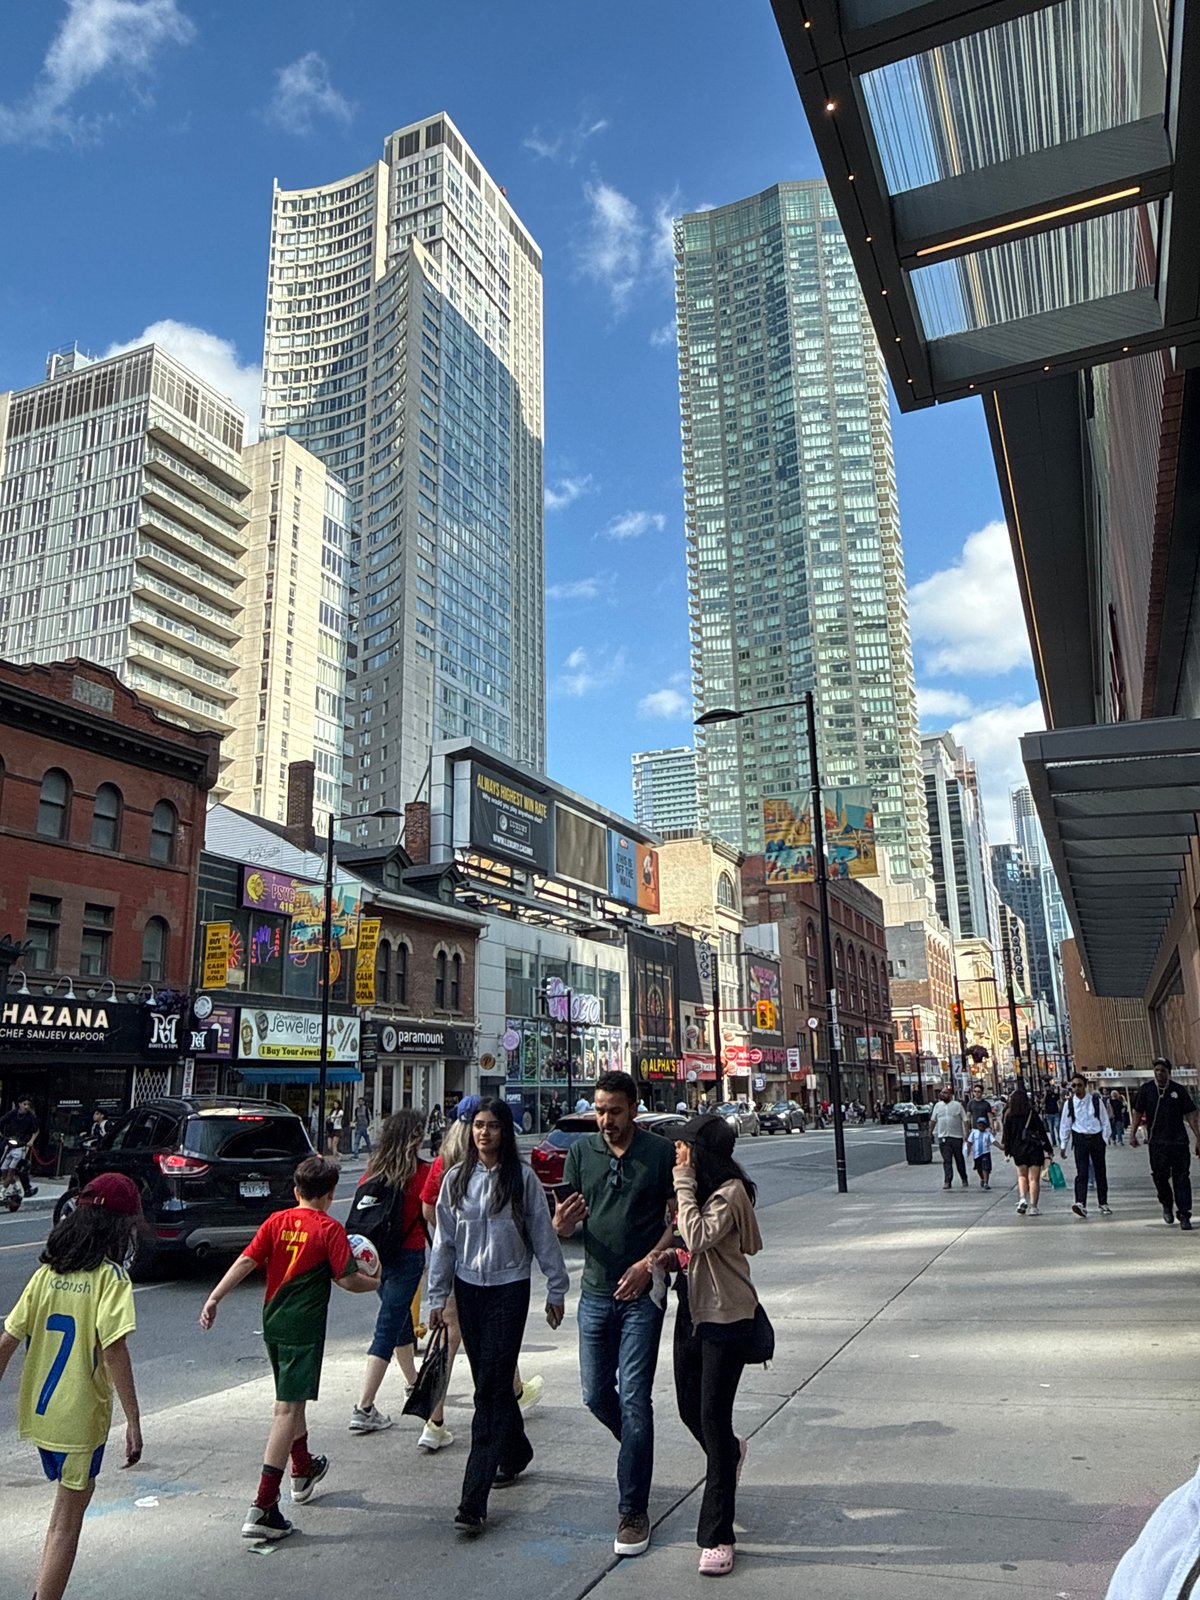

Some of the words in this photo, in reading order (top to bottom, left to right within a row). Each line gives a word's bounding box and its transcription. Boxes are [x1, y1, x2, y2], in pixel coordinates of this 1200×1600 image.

[477, 773, 500, 797] ALWAYS
[500, 784, 523, 807] HIGHEST
[523, 796, 534, 813] WIN
[534, 801, 548, 819] RATE
[356, 972, 373, 981] CASH
[355, 991, 374, 1000] GOLD
[276, 1013, 303, 1022] Downtown
[270, 1016, 323, 1035] Jeweller
[0, 1028, 24, 1038] CHEF
[26, 1029, 67, 1040] SANJEEV
[69, 1031, 105, 1041] KAPOOR
[305, 1035, 323, 1043] Mar
[398, 1031, 444, 1047] paramount
[261, 1046, 265, 1055] I
[266, 1046, 281, 1056] Buy
[281, 1047, 298, 1055] Your
[299, 1048, 333, 1058] Jewellry
[649, 1058, 676, 1073] ALPHA'S
[286, 1245, 299, 1270] 7
[35, 1313, 76, 1416] 7
